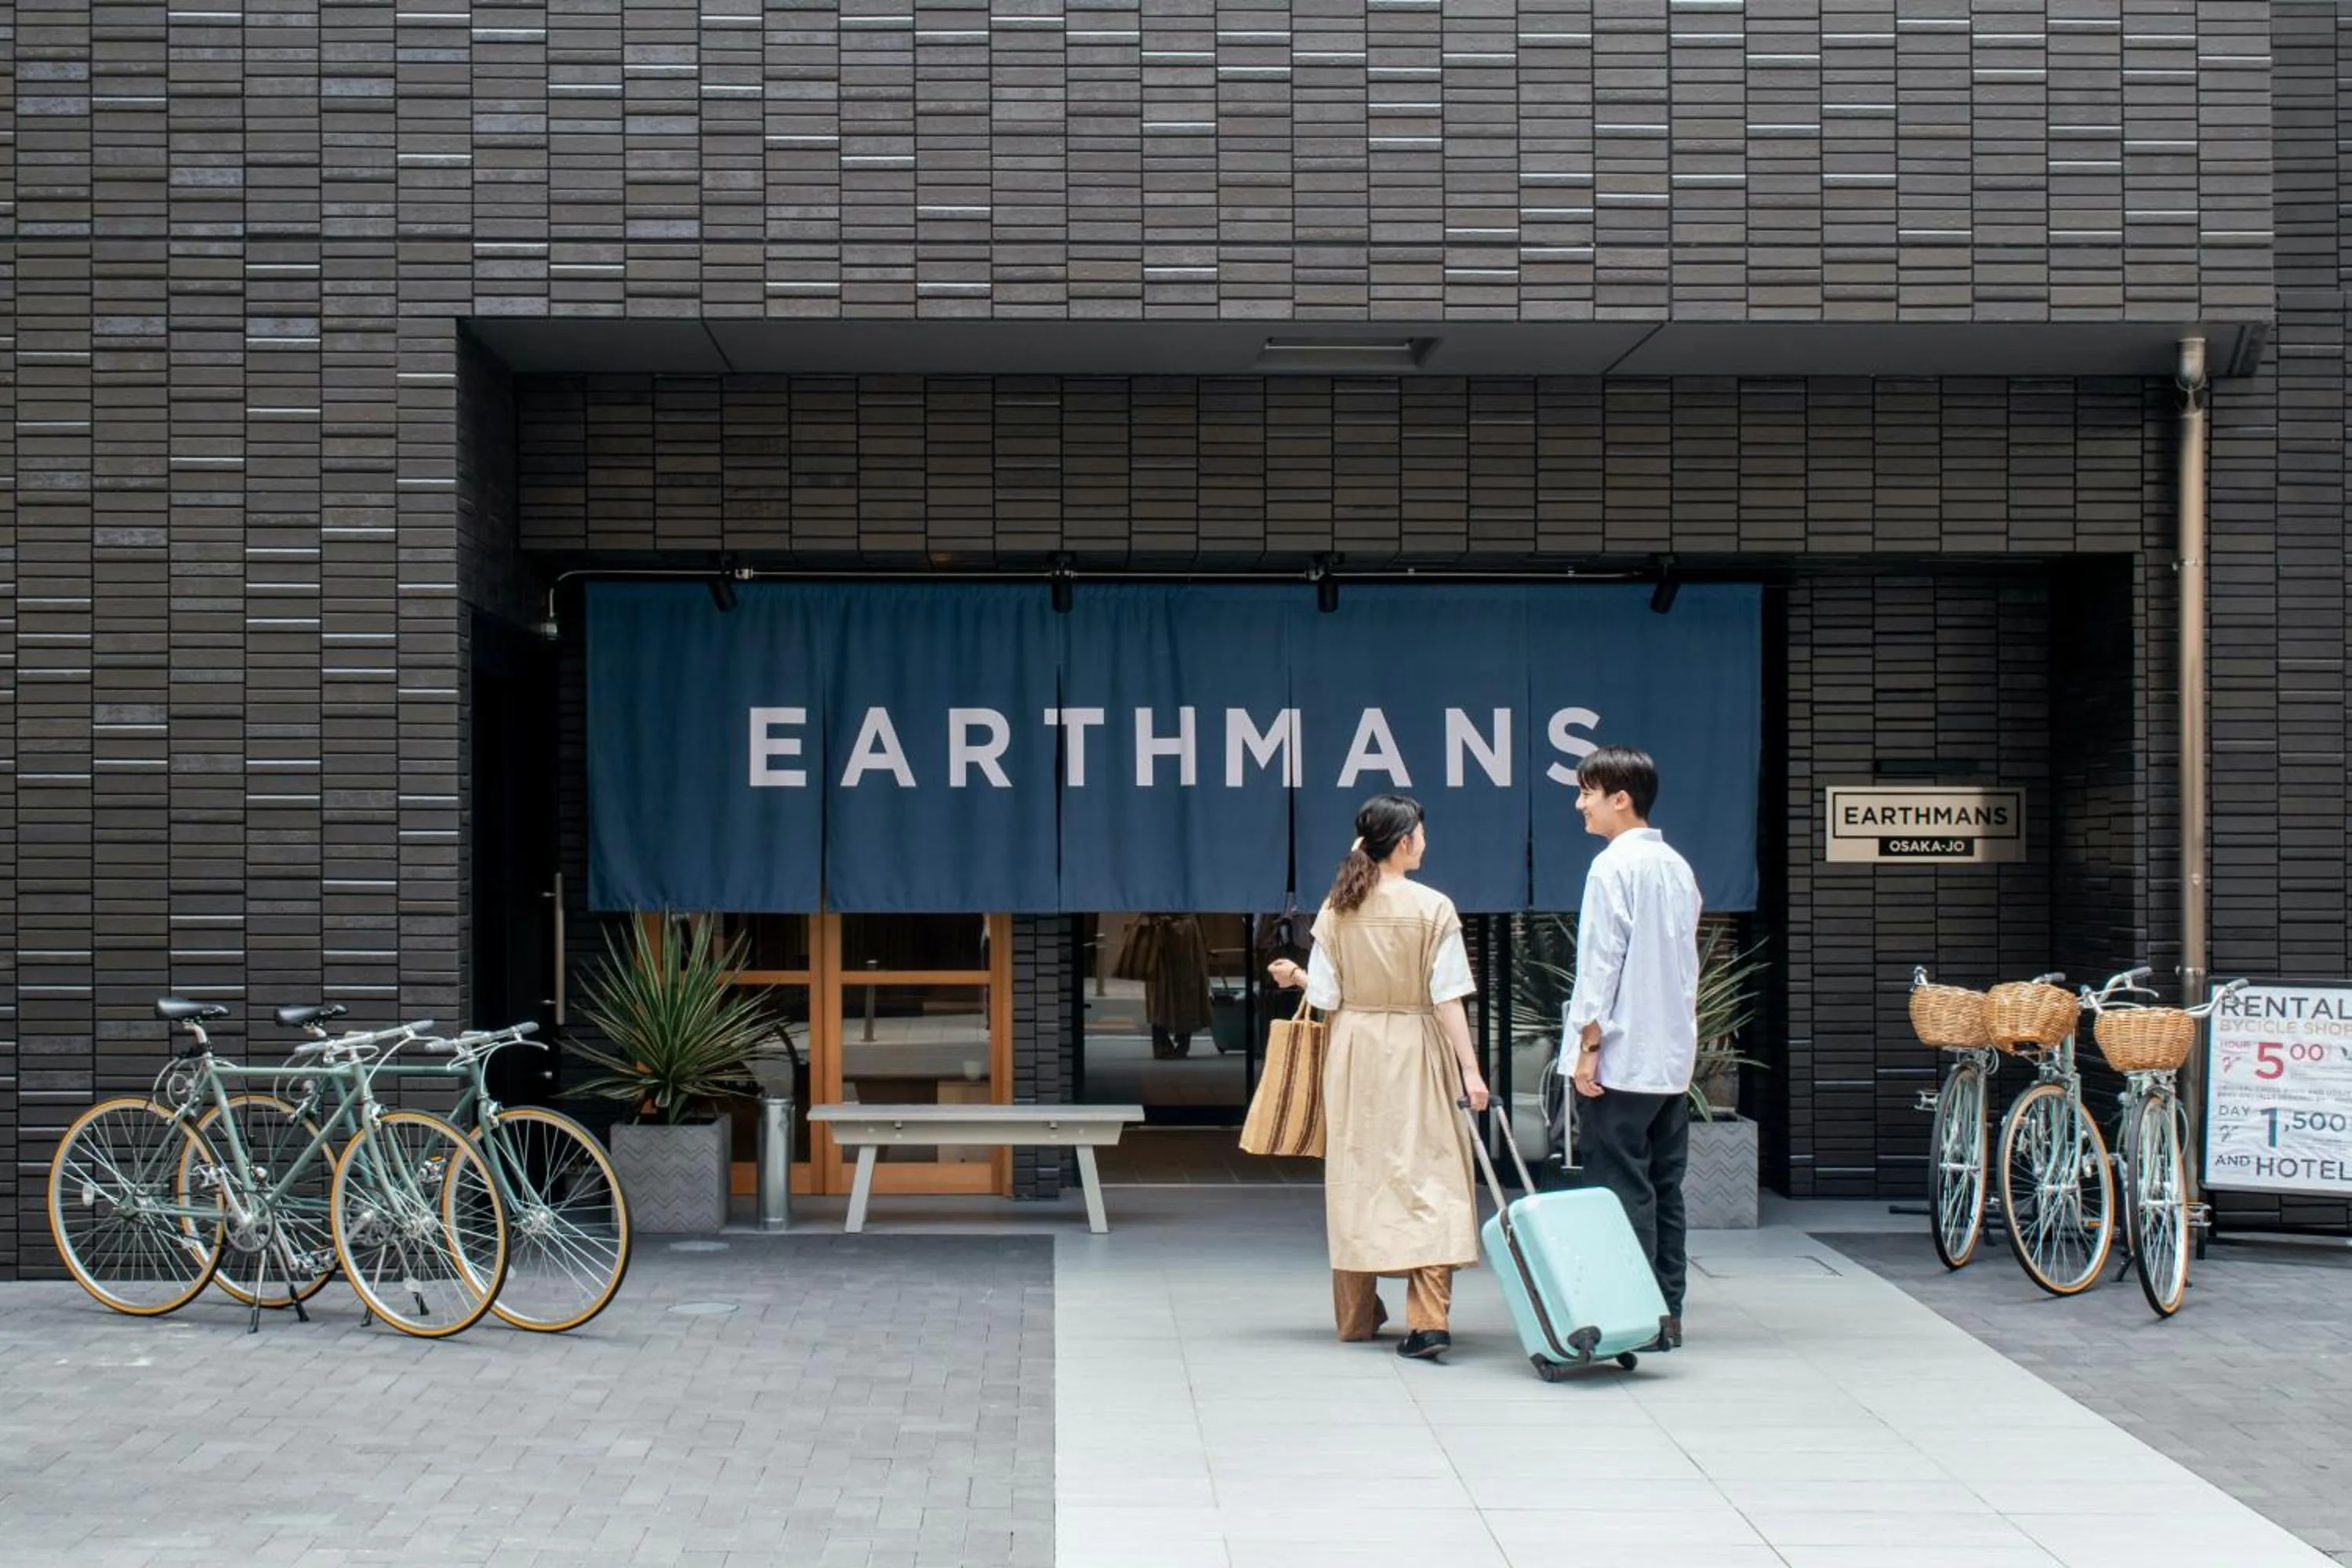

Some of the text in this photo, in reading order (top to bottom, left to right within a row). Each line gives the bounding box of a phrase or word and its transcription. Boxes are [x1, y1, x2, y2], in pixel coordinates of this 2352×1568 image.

[748, 706, 1600, 789] EARTHMANS
[1844, 806, 2009, 826] EARTHMANS
[1888, 840, 1965, 853] OSAKA-JO
[2220, 994, 2352, 1020] RENTAL
[2219, 1105, 2251, 1117] DAY
[2215, 1154, 2352, 1181] AND HOTEL
